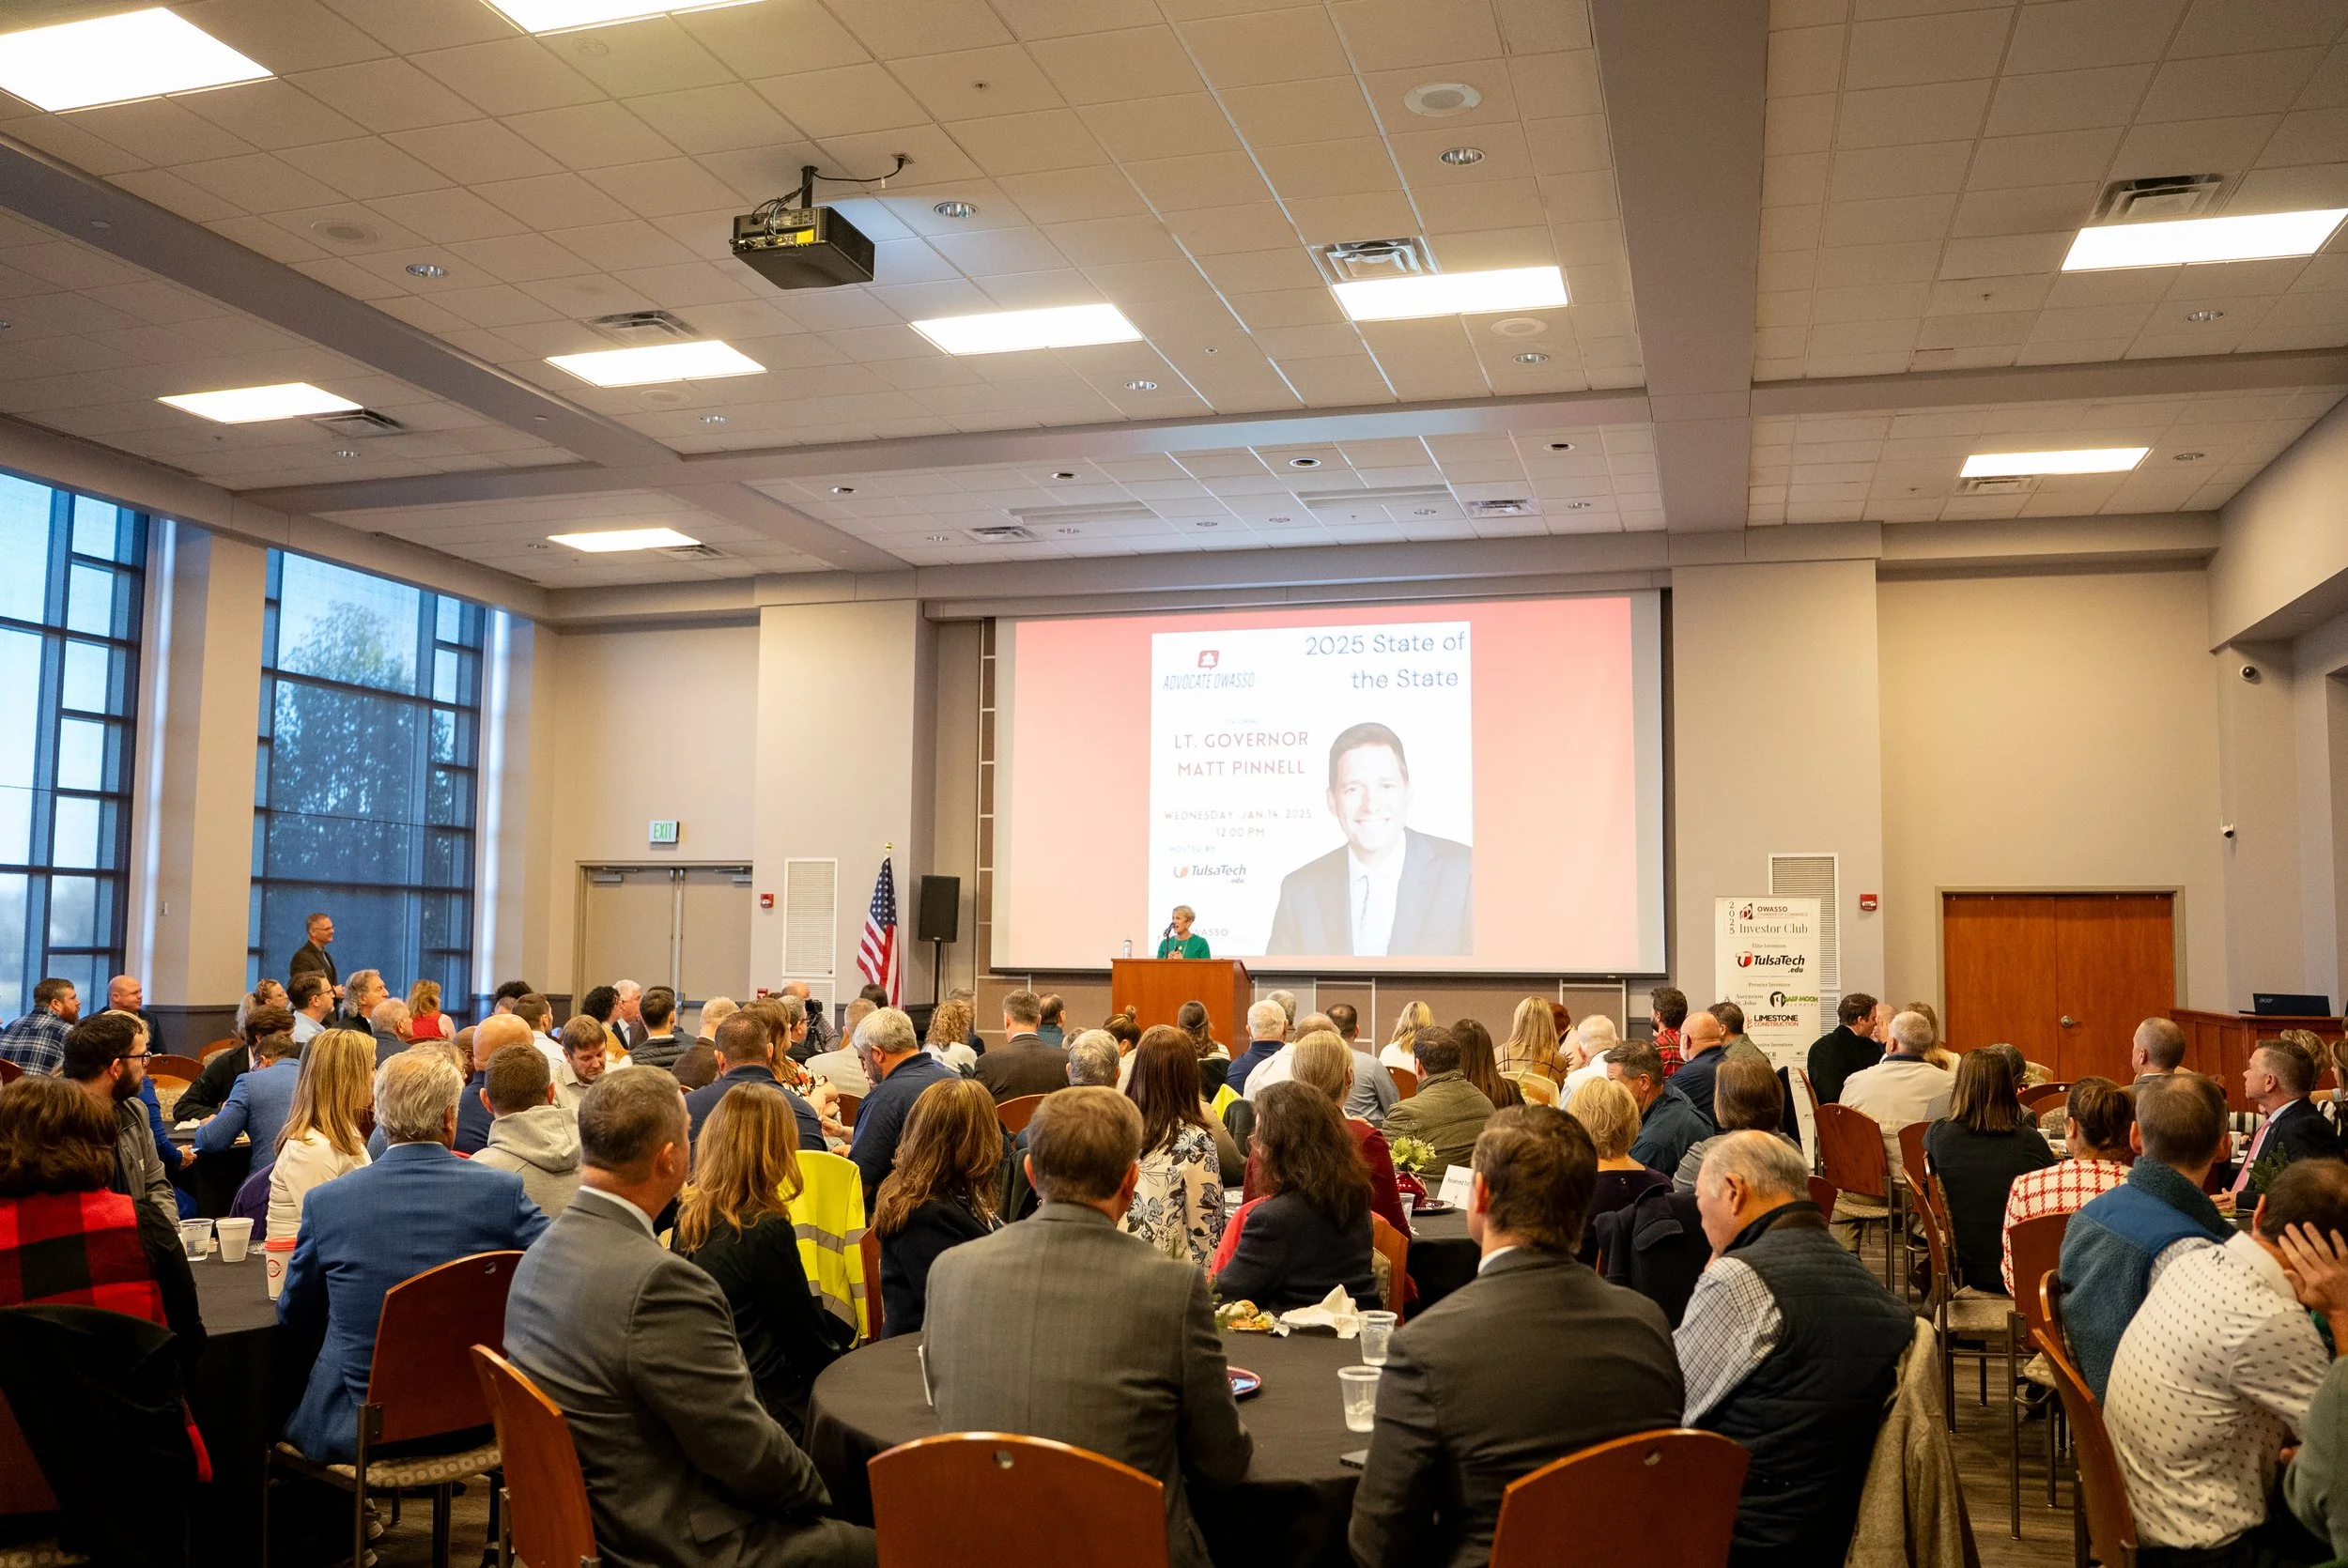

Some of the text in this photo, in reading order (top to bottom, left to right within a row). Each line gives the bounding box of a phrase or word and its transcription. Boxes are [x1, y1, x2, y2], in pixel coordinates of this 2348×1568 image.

[1305, 631, 1465, 655] 2025 State of
[1164, 671, 1255, 690] ADVOCATE OWASSO
[1352, 669, 1459, 688] the State
[1175, 731, 1308, 748] LT. GOVERNOR
[1178, 760, 1305, 776] MATT PINNELL
[1242, 810, 1263, 819] JAN
[1285, 809, 1312, 819] 2025
[654, 822, 673, 839] EXIT
[1247, 827, 1265, 837] PM
[1192, 865, 1246, 876] TulsaTech
[1739, 923, 1808, 933] Investor Club
[1754, 955, 1805, 965] TulsaTech
